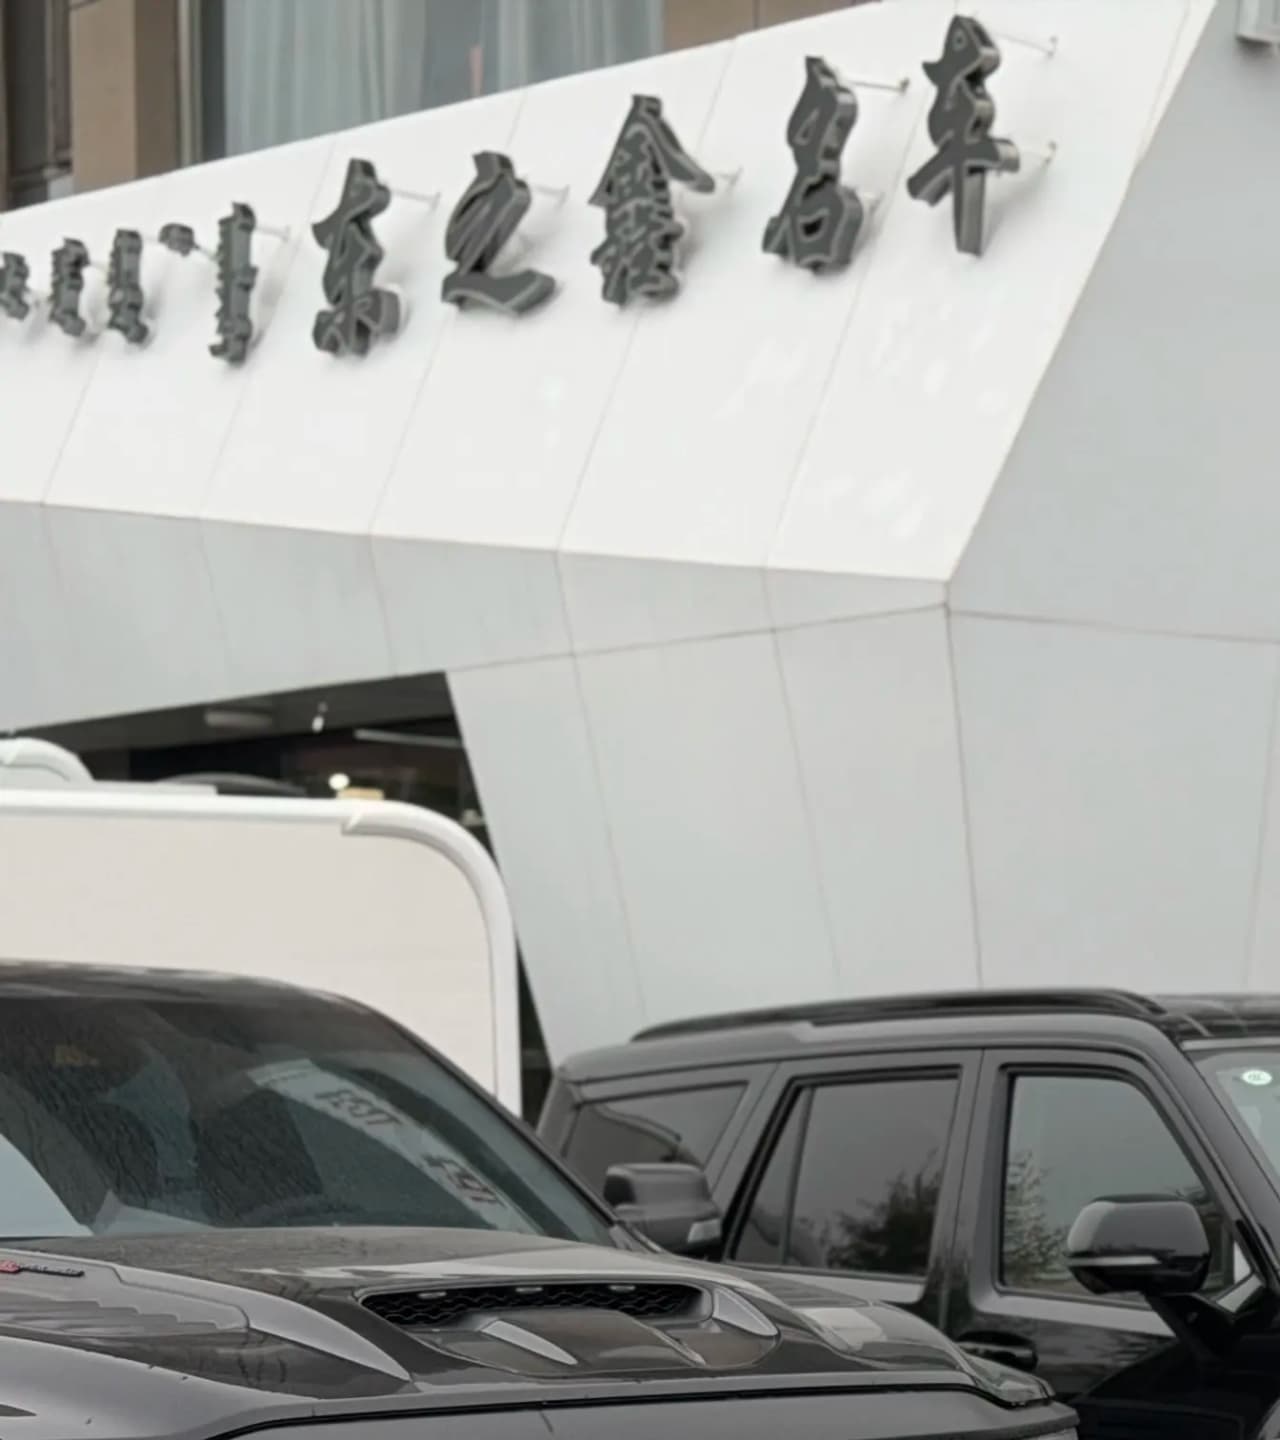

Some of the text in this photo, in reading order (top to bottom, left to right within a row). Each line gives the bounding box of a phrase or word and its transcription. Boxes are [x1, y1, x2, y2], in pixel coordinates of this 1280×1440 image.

[310, 13, 1021, 357] 东之鑫名车
